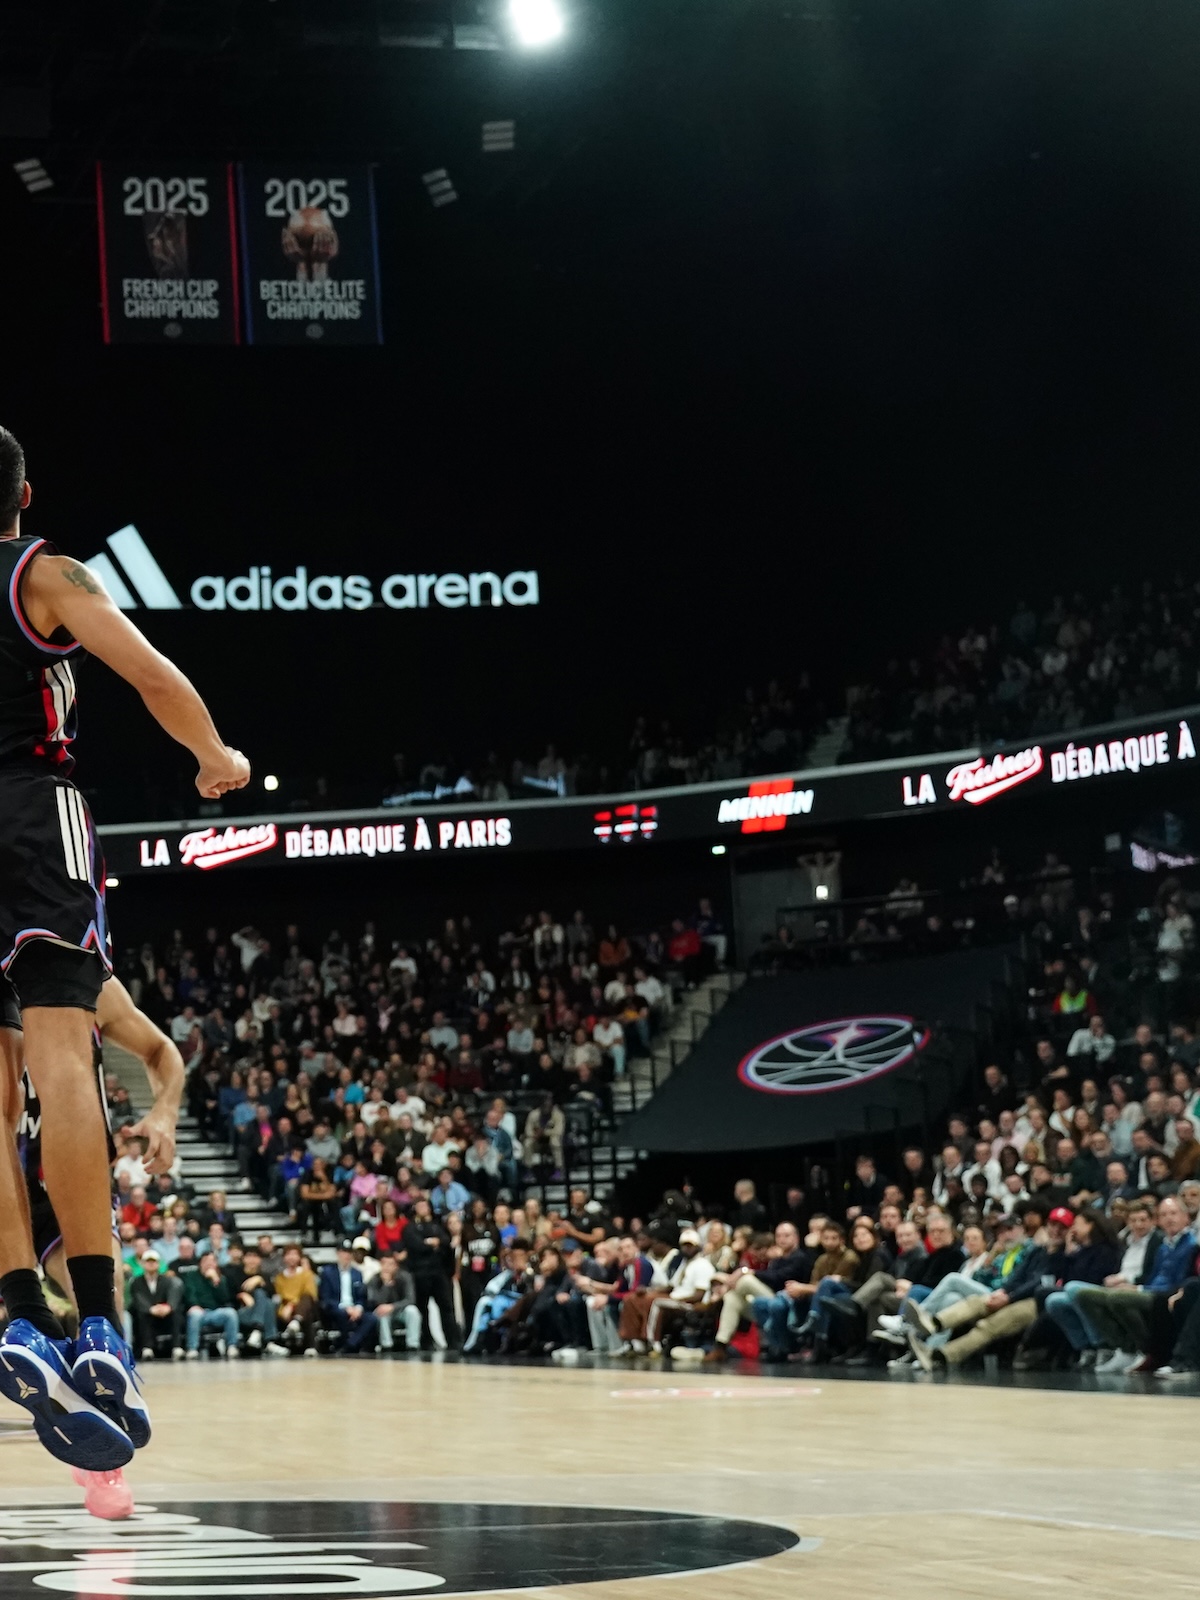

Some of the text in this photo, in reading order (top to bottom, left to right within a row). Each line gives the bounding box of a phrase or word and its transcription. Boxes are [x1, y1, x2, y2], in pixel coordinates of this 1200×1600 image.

[122, 176, 211, 217] 2025
[264, 178, 350, 218] 2025
[122, 278, 220, 301] FRENCH CUP
[328, 279, 366, 300] ELITE
[124, 299, 220, 319] CHAMPIONS
[266, 300, 362, 320] CHAMPIONS
[190, 565, 540, 611] adidas arena
[902, 773, 937, 806] LA
[1050, 742, 1171, 784] DÉBARQUE
[1177, 720, 1197, 760] À
[718, 789, 815, 823] MENNEN
[140, 838, 171, 867] LA
[285, 823, 407, 859] DÉBARQUE
[413, 816, 432, 851] À
[439, 817, 513, 850] PARIS
